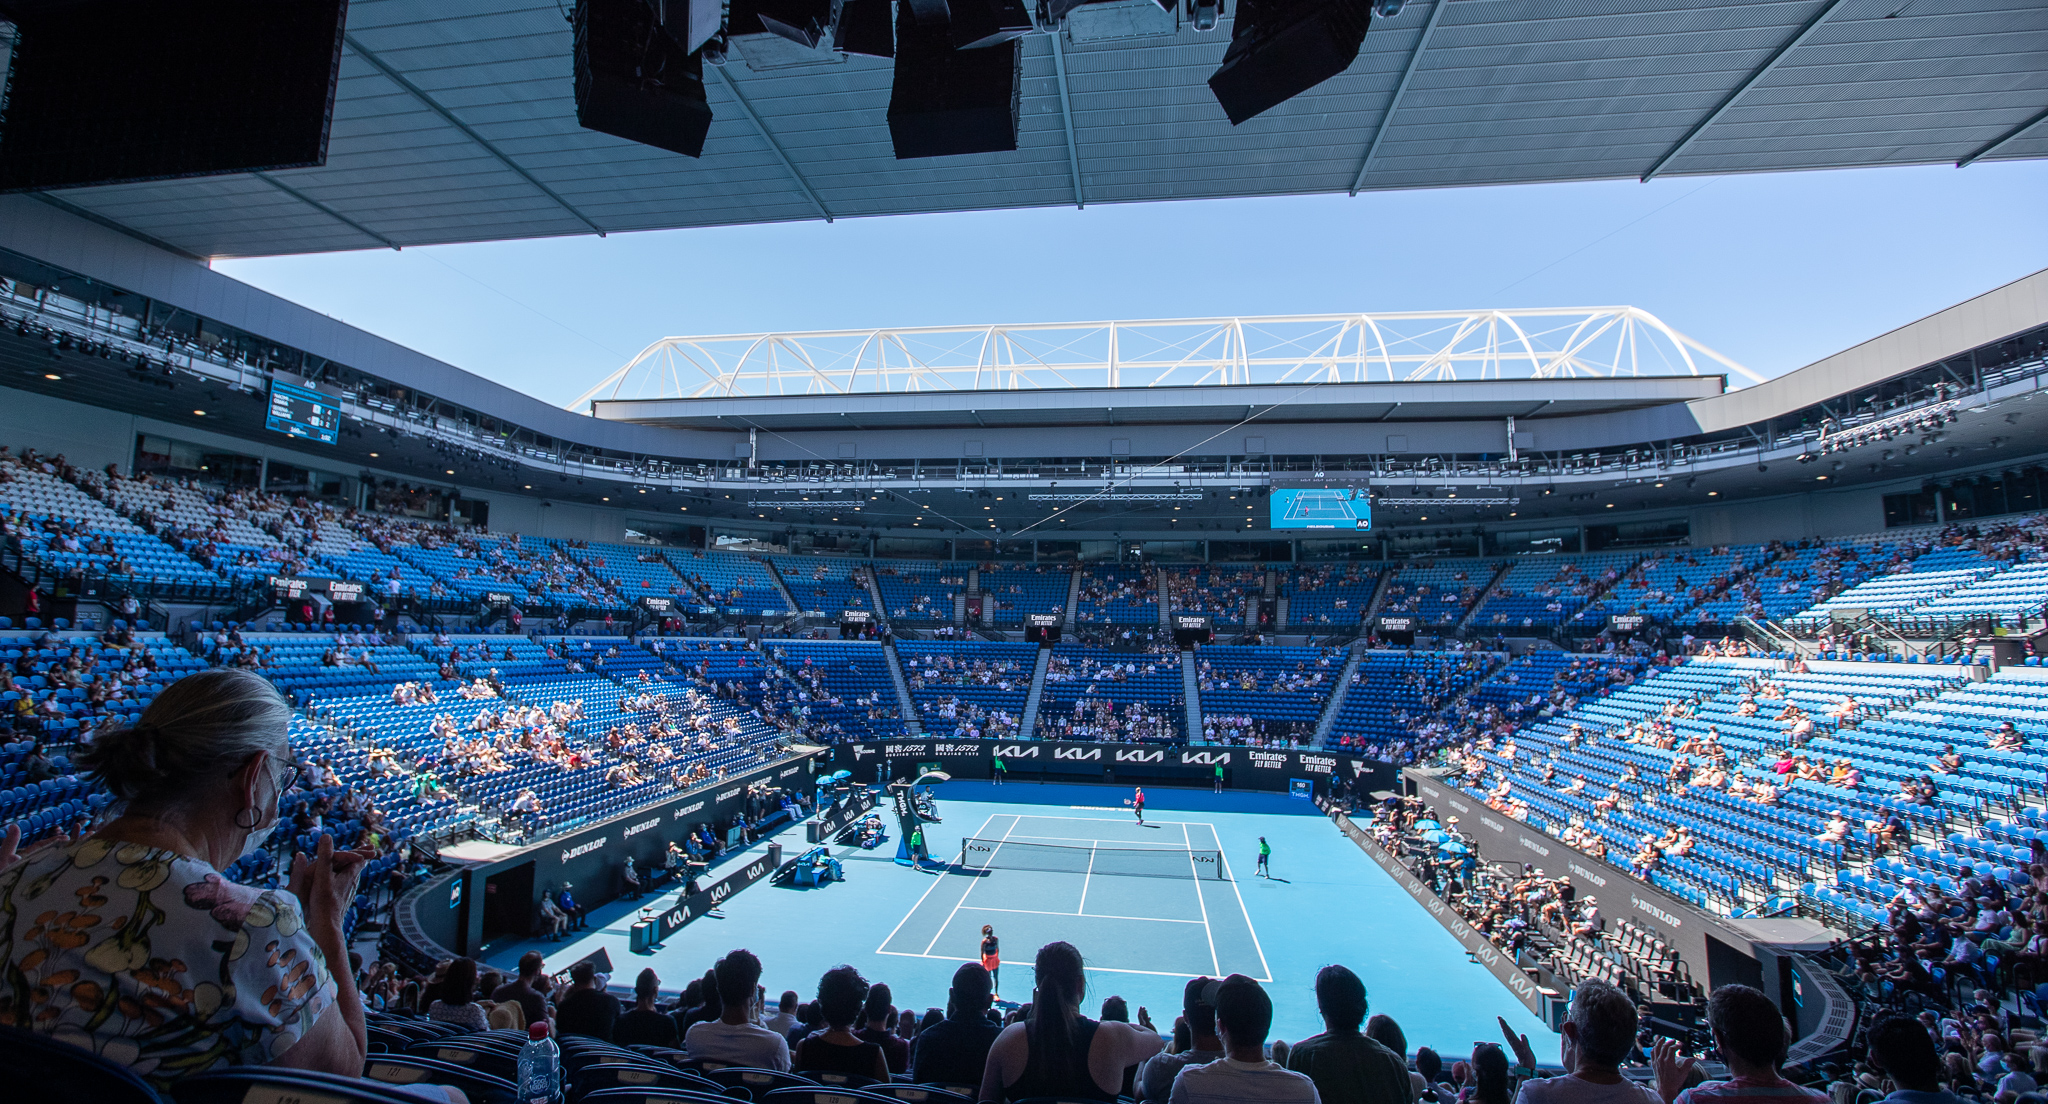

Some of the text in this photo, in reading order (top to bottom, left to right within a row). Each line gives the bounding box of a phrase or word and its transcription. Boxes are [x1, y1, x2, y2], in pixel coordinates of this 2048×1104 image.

[1357, 520, 1369, 528] AO
[330, 581, 362, 592] Emirates
[845, 610, 870, 618] Emirates
[1612, 615, 1643, 624] Emirates
[993, 745, 1039, 758] KIA
[1054, 747, 1101, 760] KIA
[1116, 749, 1164, 762] KIA
[1182, 751, 1231, 764] KIA
[1249, 751, 1287, 762] Emirates
[1254, 760, 1282, 769] FLY BETTER
[1300, 754, 1336, 766] Emirates
[1304, 764, 1332, 774] FLY BETTER
[720, 788, 740, 802] DUNLOP
[679, 801, 704, 817] DUNLOP
[630, 817, 660, 836] DUNLOP
[1484, 817, 1504, 832] DUNLOP
[569, 837, 607, 858] DUNLOP
[1524, 838, 1550, 856] DUNLOP
[746, 862, 764, 880] KIA
[1574, 864, 1606, 887] DUNLOP
[710, 882, 731, 901] KIA
[1428, 898, 1445, 916] KIA
[1638, 899, 1682, 928] DUNLOP
[667, 905, 691, 928] KIA
[1450, 920, 1470, 940] KIA
[1476, 944, 1499, 966] KIA
[1508, 972, 1534, 1000] KIA
[387, 1067, 401, 1076] 121
